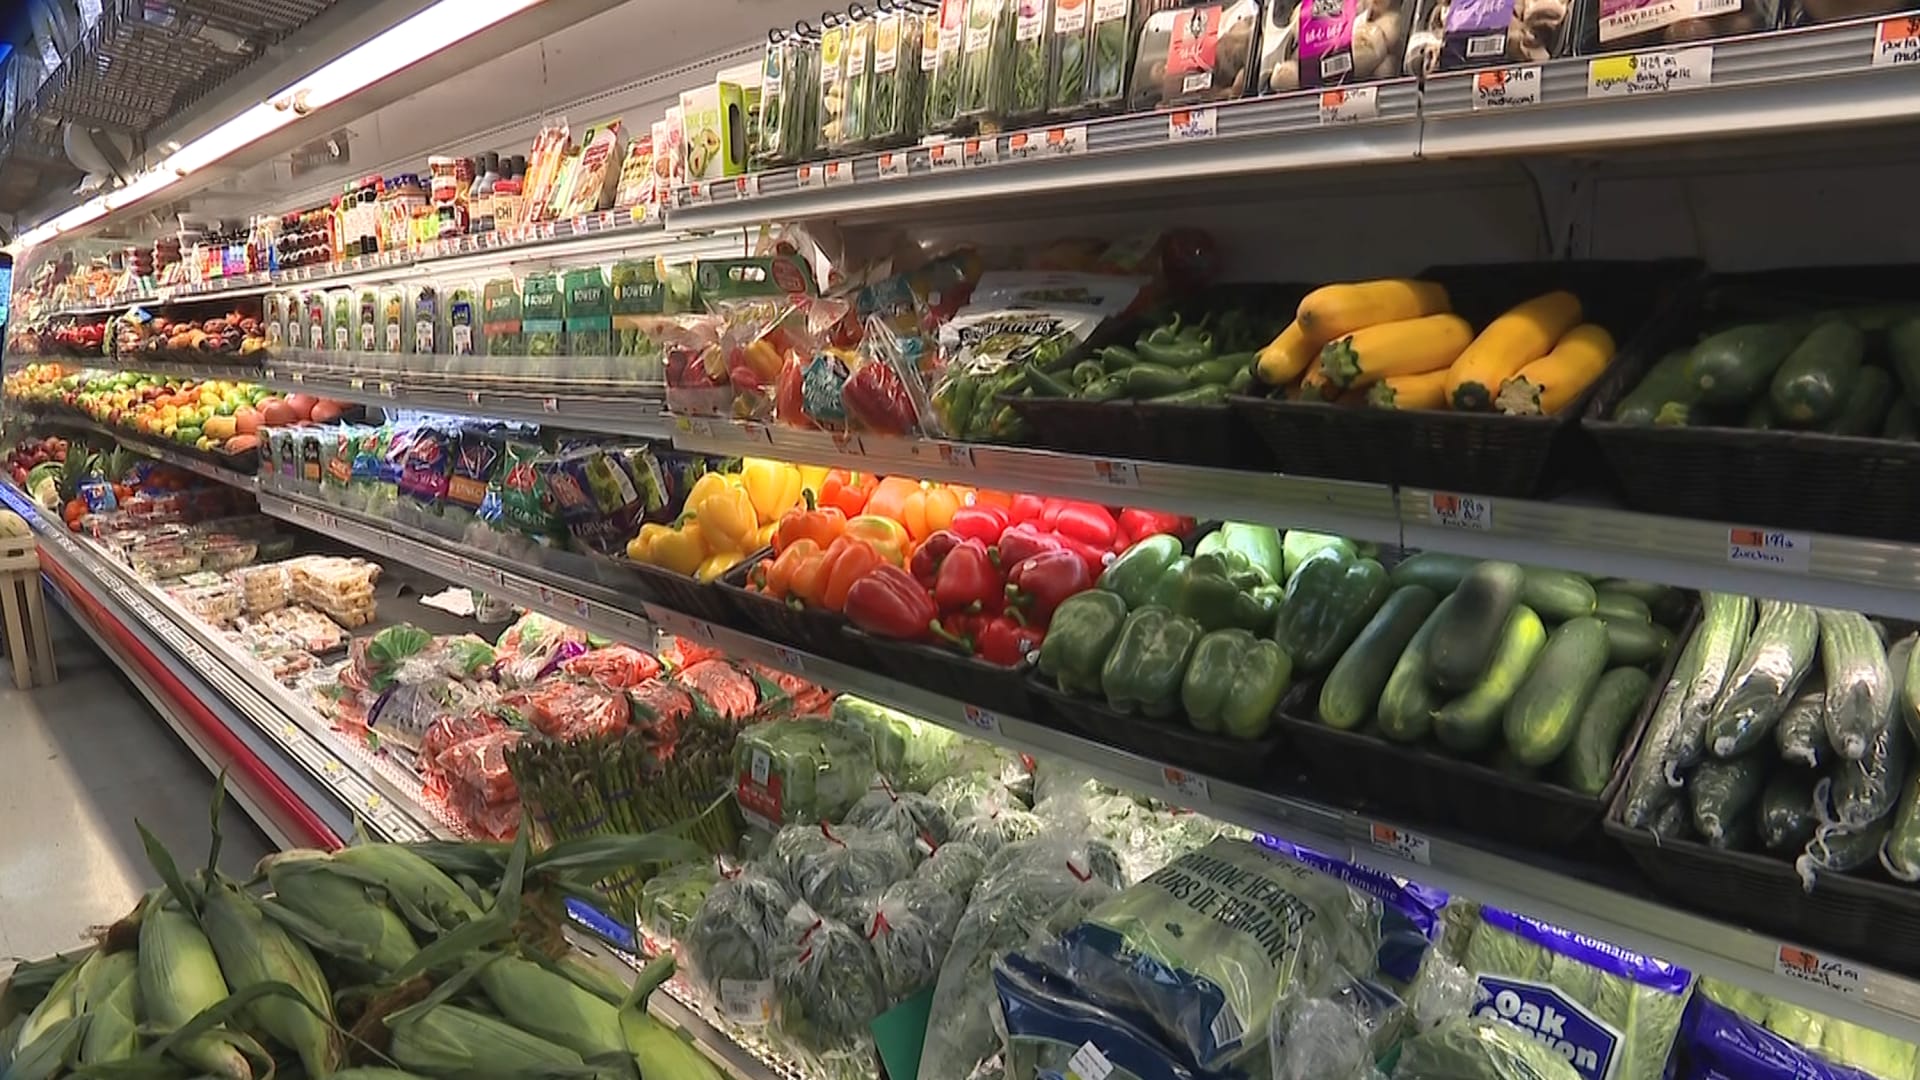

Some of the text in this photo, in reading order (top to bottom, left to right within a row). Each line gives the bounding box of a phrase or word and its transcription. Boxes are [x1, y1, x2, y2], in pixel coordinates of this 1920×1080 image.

[1609, 12, 1637, 27] BABY
[1640, 3, 1676, 20] BELLA
[621, 284, 653, 298] BOWERY
[1187, 887, 1221, 915] DE
[1573, 933, 1645, 967] Romaine
[1494, 989, 1567, 1040] Oak
